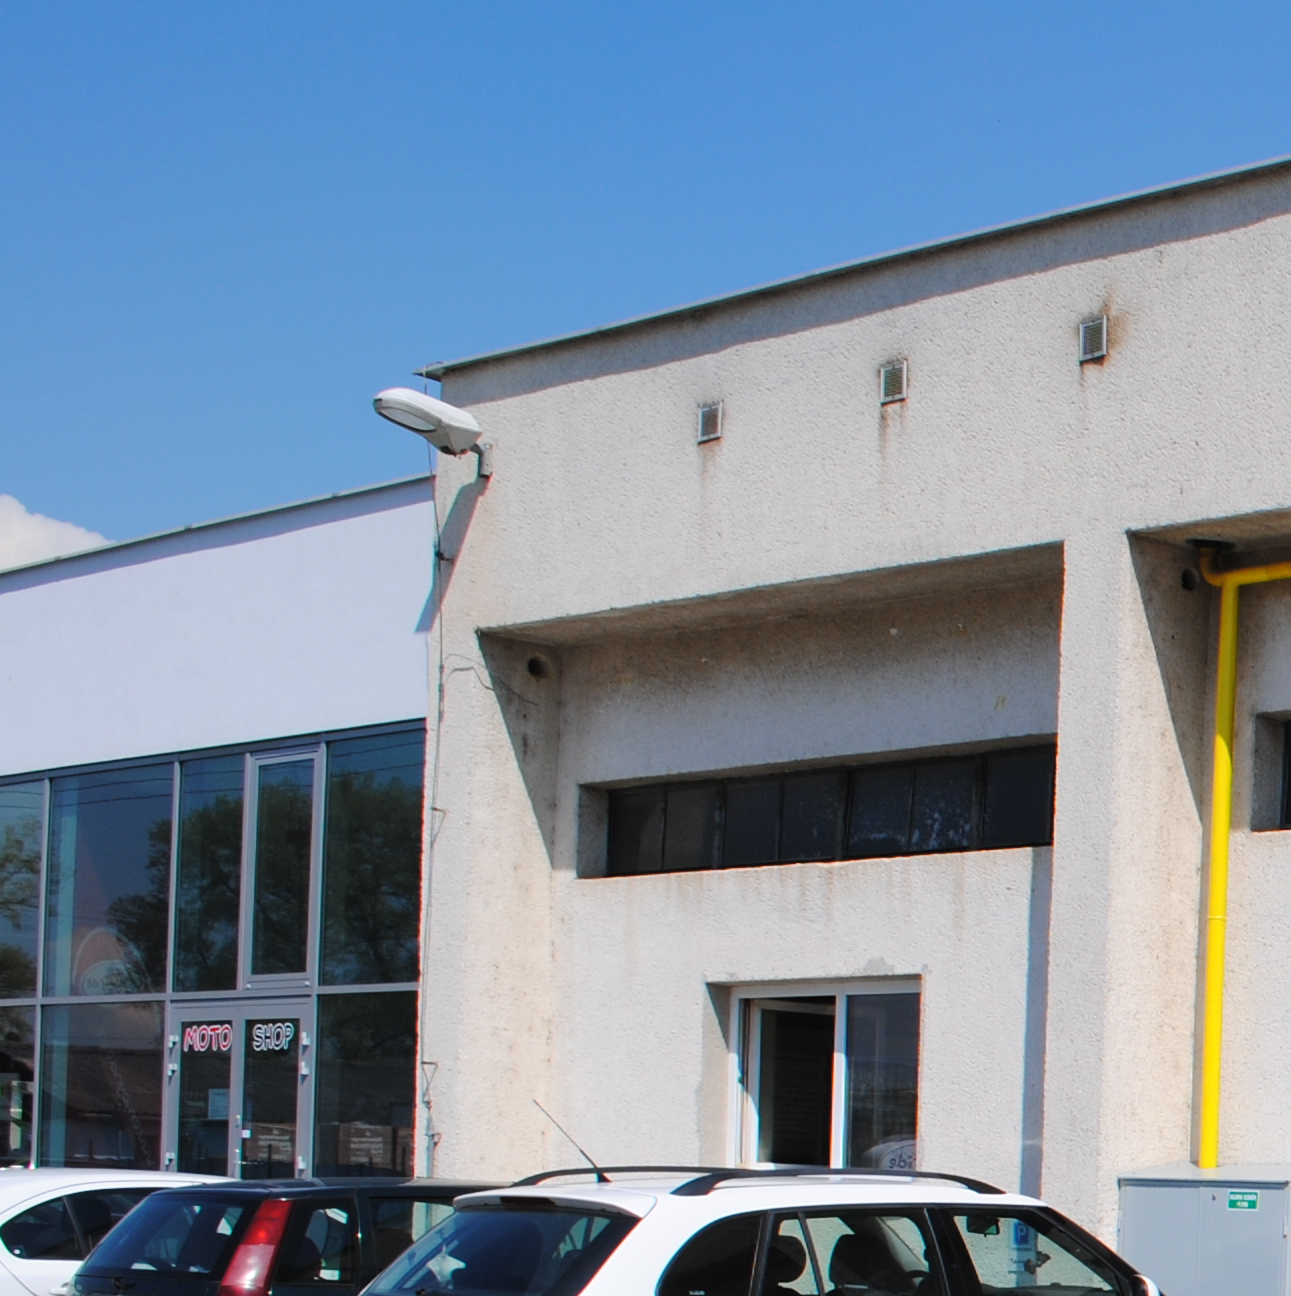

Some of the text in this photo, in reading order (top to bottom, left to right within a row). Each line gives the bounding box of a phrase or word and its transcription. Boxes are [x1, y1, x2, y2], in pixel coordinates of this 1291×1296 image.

[183, 1022, 294, 1052] MOTO SHOP
[1017, 1225, 1027, 1241] P
